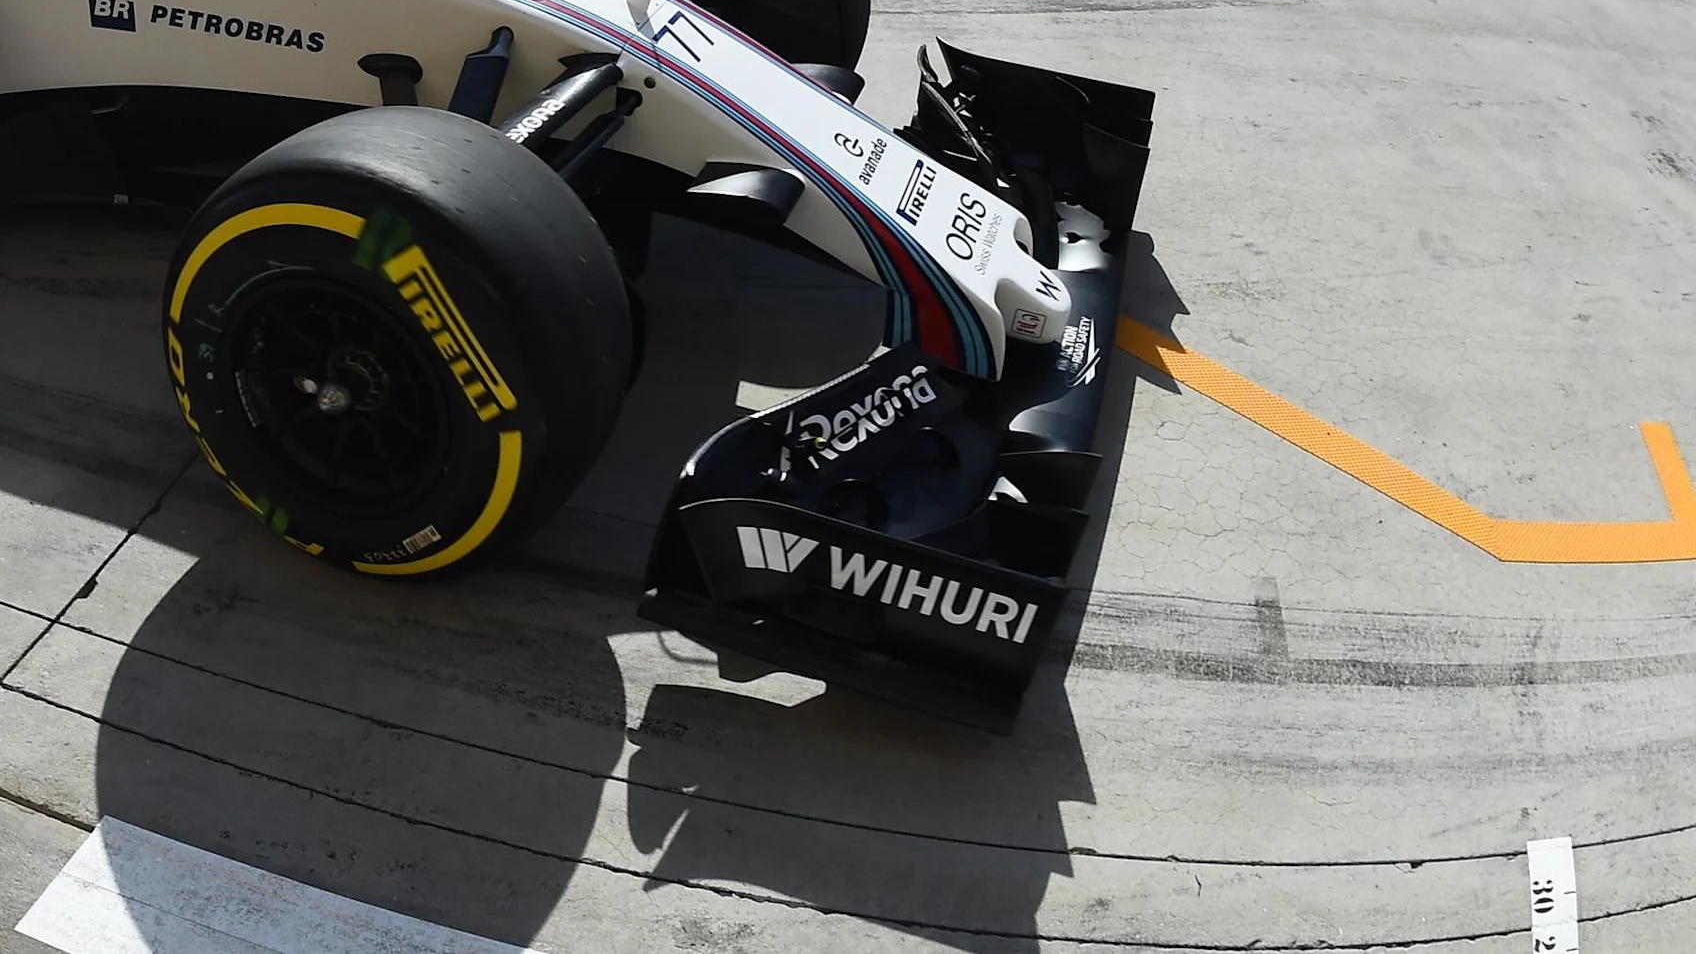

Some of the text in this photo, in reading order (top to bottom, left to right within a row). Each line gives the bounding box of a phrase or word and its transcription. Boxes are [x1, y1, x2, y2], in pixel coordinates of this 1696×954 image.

[150, 4, 325, 53] PETROBRAS
[654, 11, 714, 62] 77
[506, 98, 565, 144] exona
[858, 138, 888, 186] avanade
[896, 159, 937, 226] PIRELLI
[946, 192, 987, 261] ORIS
[974, 248, 992, 276] Swiss
[380, 245, 517, 423] PIRELLI
[1060, 325, 1079, 360] ACTION
[1072, 342, 1086, 364] ROAD
[1077, 316, 1091, 344] SAFETY
[829, 545, 1038, 644] WIHURI
[1532, 879, 1555, 914] 30
